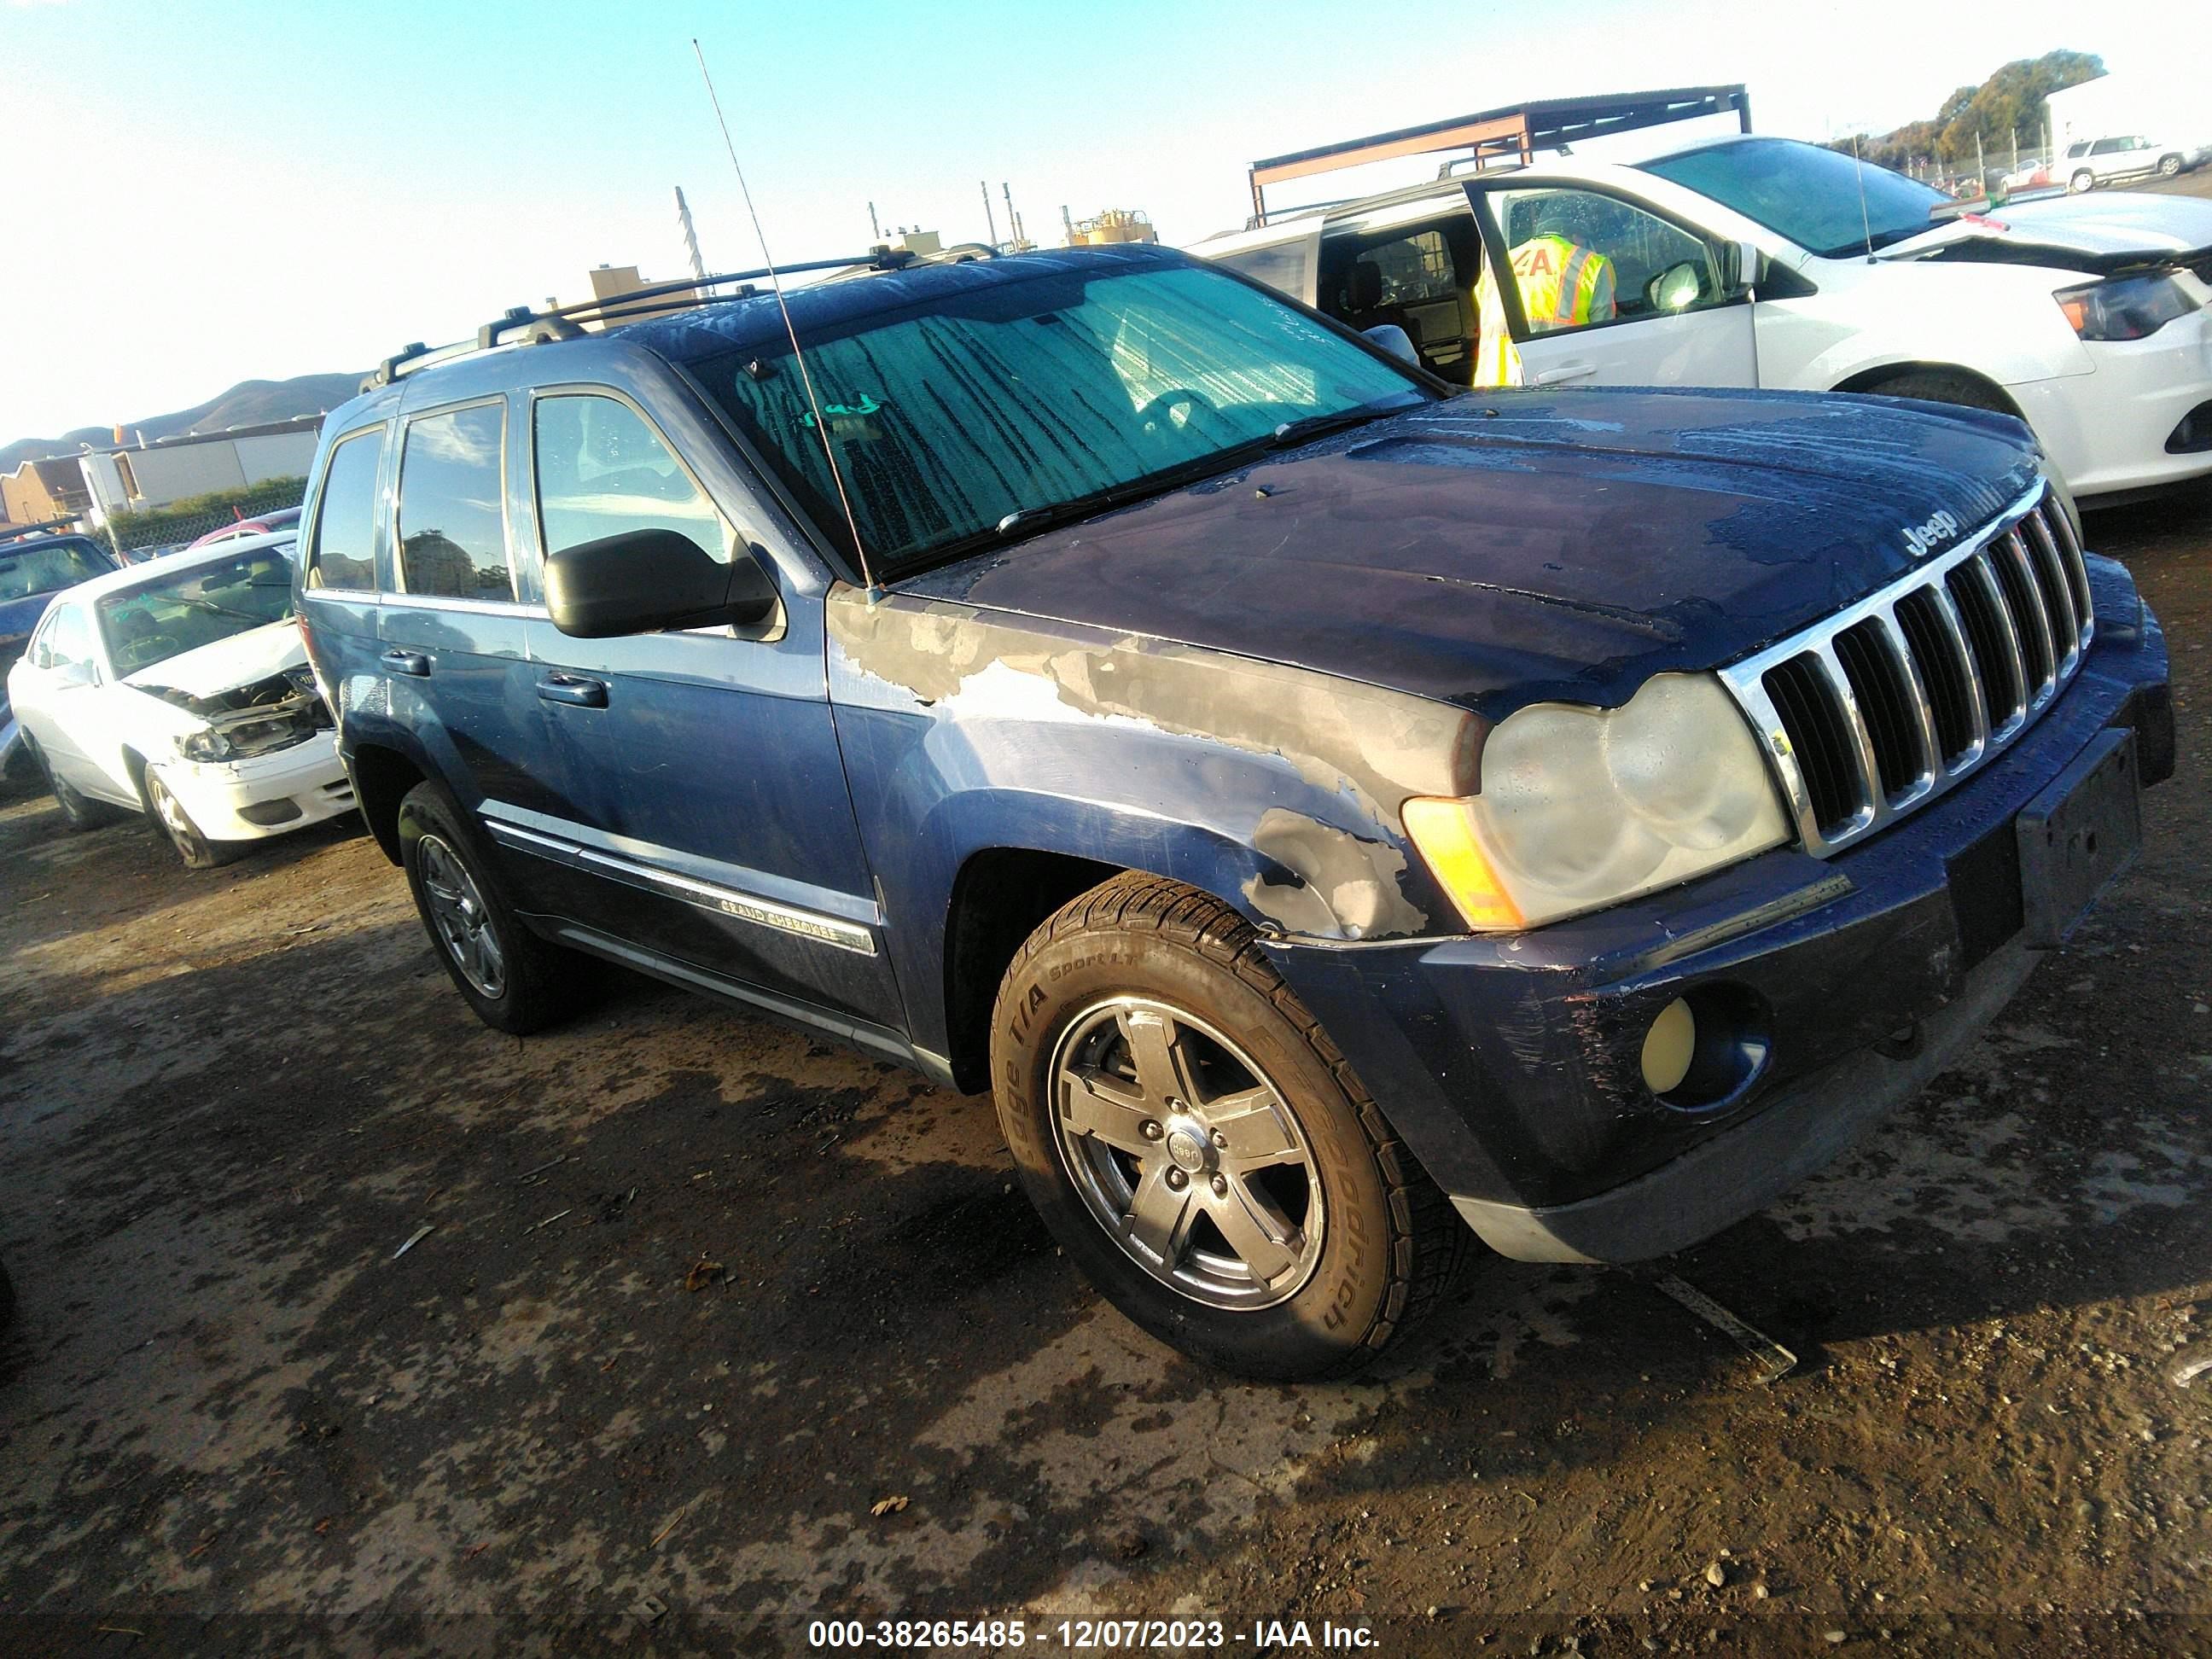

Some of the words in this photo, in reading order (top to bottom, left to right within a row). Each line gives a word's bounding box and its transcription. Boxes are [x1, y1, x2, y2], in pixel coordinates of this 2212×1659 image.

[1902, 509, 1958, 556] Jeep
[720, 899, 765, 921] GRAND
[767, 912, 838, 940] CHEROKEE
[1009, 982, 1048, 1046] T/A
[1049, 952, 1105, 982] Sport
[1110, 952, 1139, 967] LT
[1241, 1024, 1370, 1331] BFGoodrich
